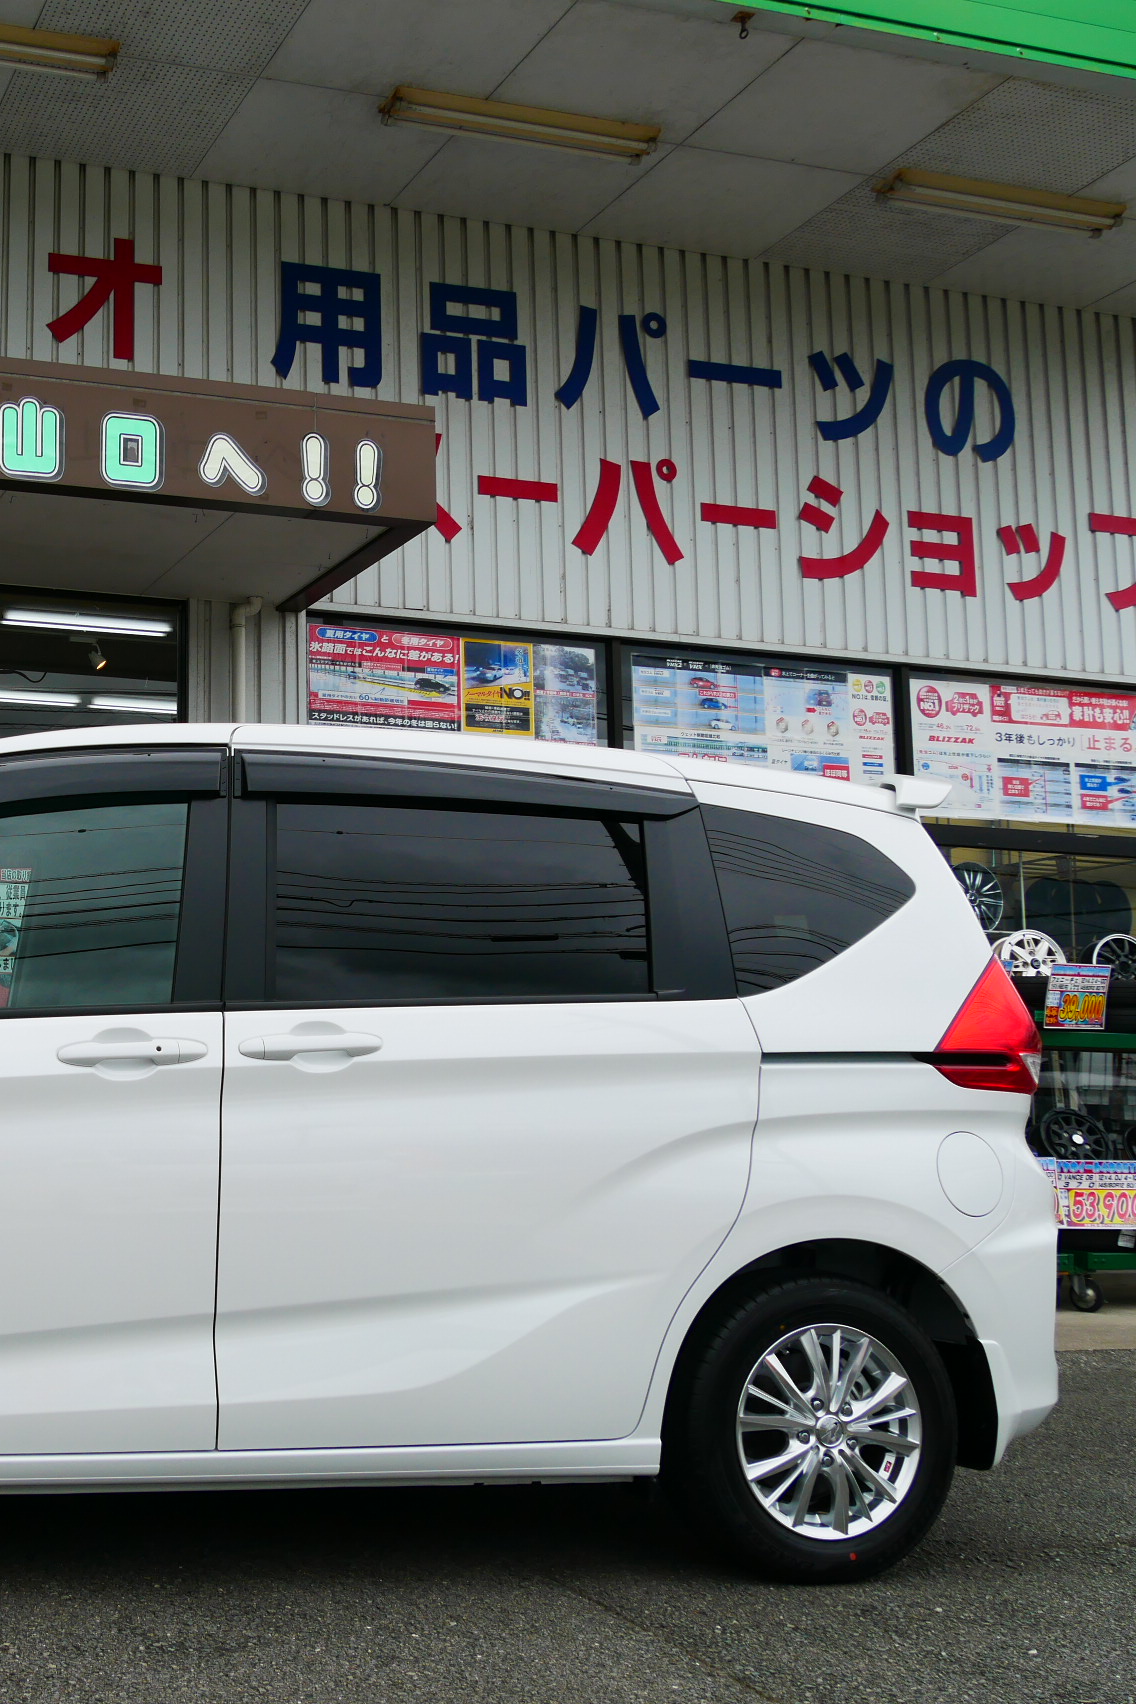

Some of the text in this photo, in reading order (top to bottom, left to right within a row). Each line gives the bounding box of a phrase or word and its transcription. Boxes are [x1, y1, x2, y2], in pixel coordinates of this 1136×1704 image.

[271, 261, 1016, 463] 用品パーツの
[435, 433, 1136, 612] ーパーショッ
[928, 735, 976, 744] BLIZZAK
[995, 732, 1076, 747] 3年後もしっかり
[1058, 992, 1105, 1022] 39,000
